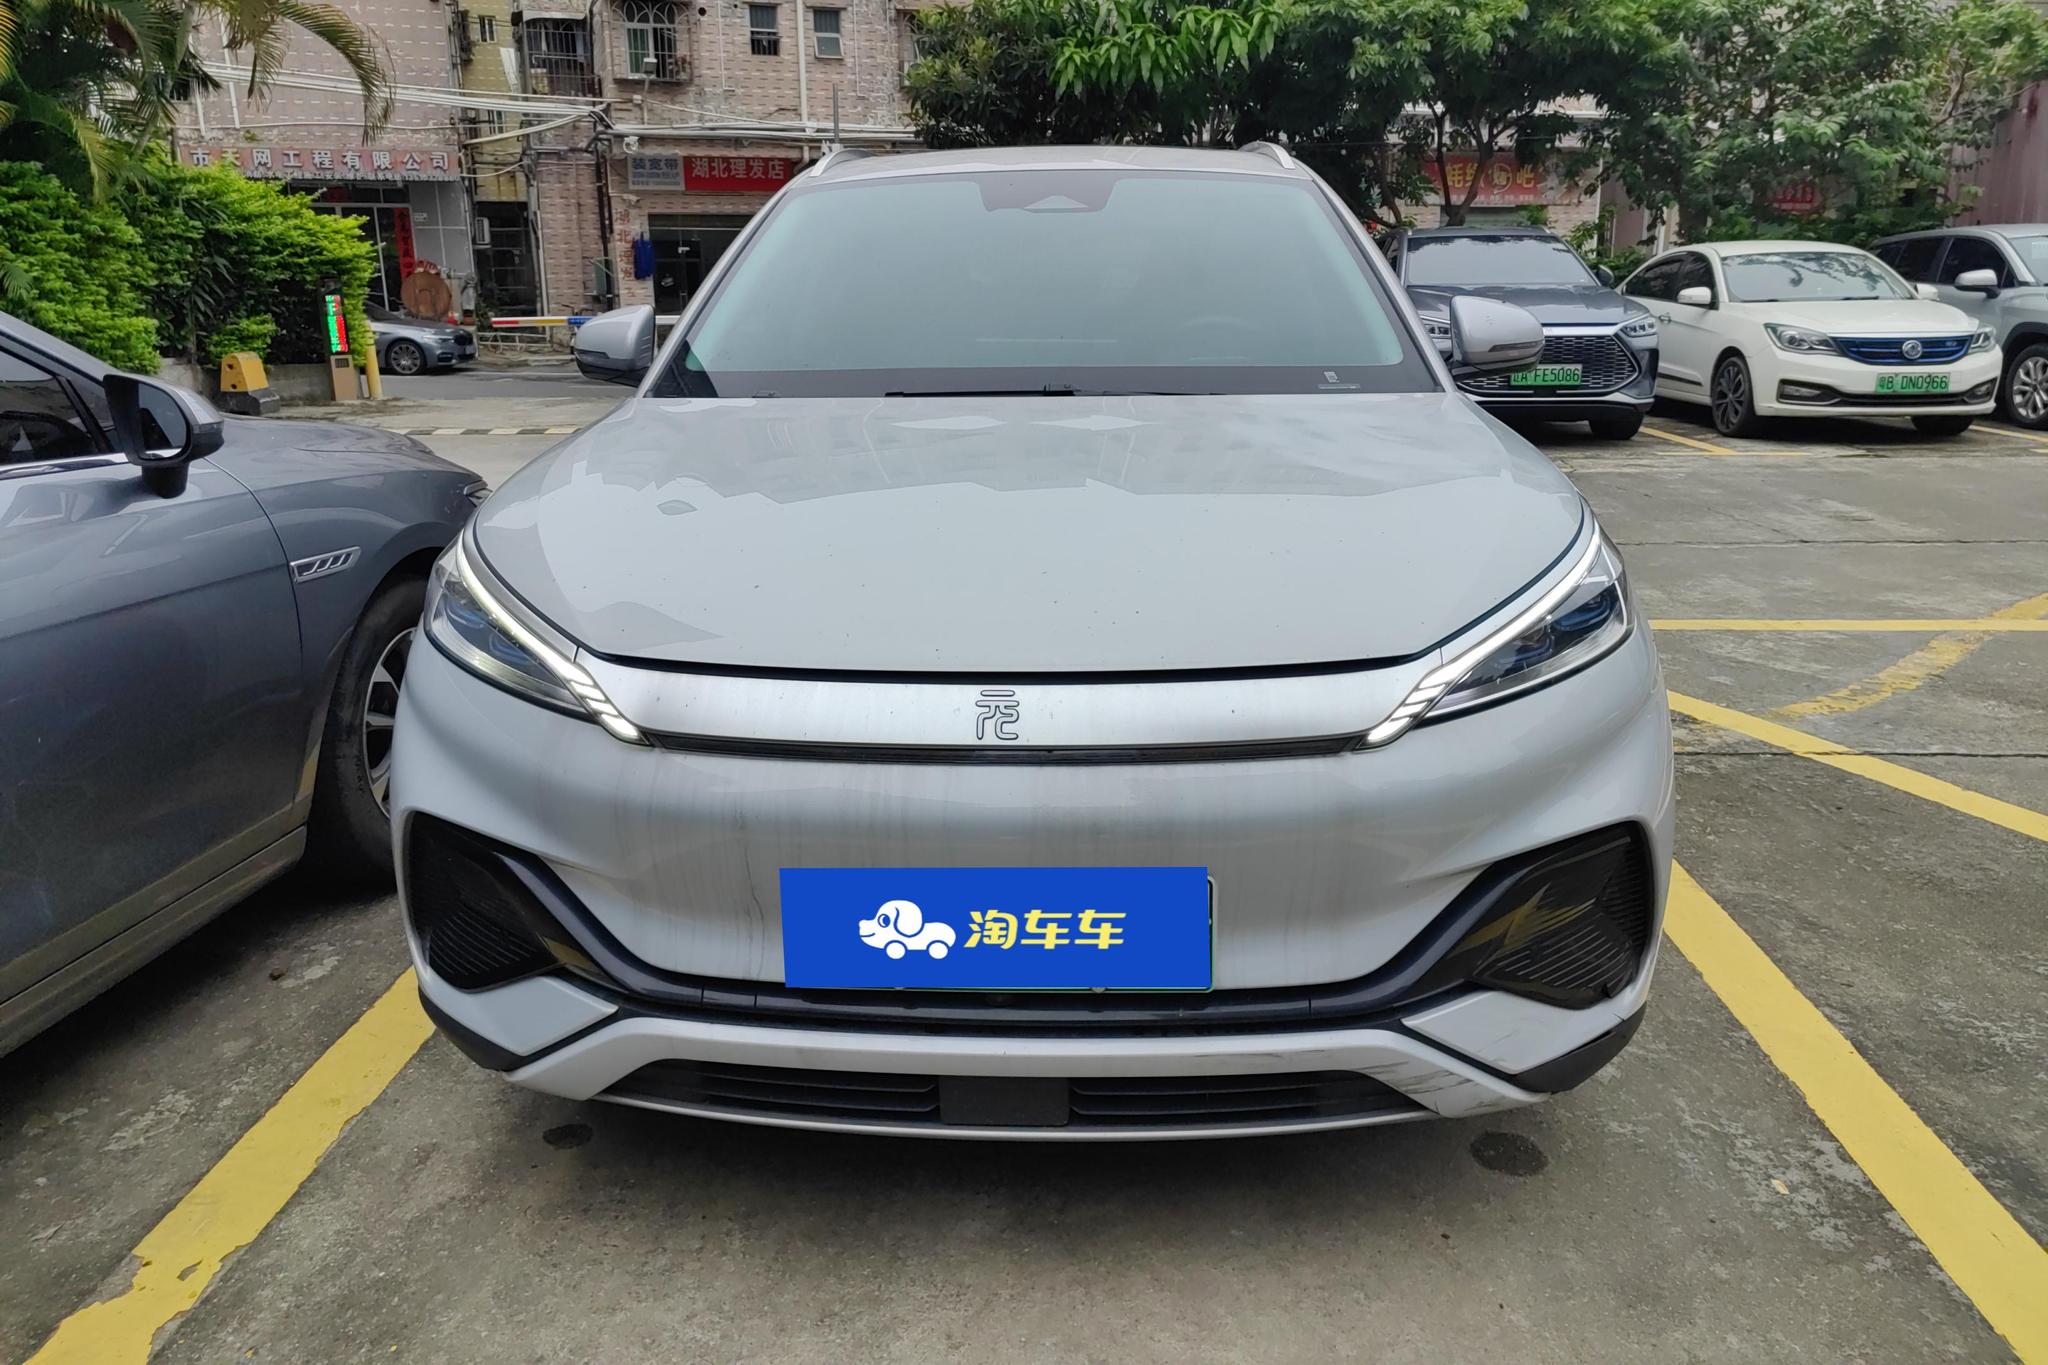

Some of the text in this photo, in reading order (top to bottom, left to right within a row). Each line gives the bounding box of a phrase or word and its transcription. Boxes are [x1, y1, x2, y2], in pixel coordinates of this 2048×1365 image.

[632, 158, 679, 171] 装宽带
[691, 158, 786, 180] 湖北理发店
[1534, 368, 1580, 383] FE5086
[1900, 375, 1948, 390] DN0966
[974, 689, 1021, 741] 元
